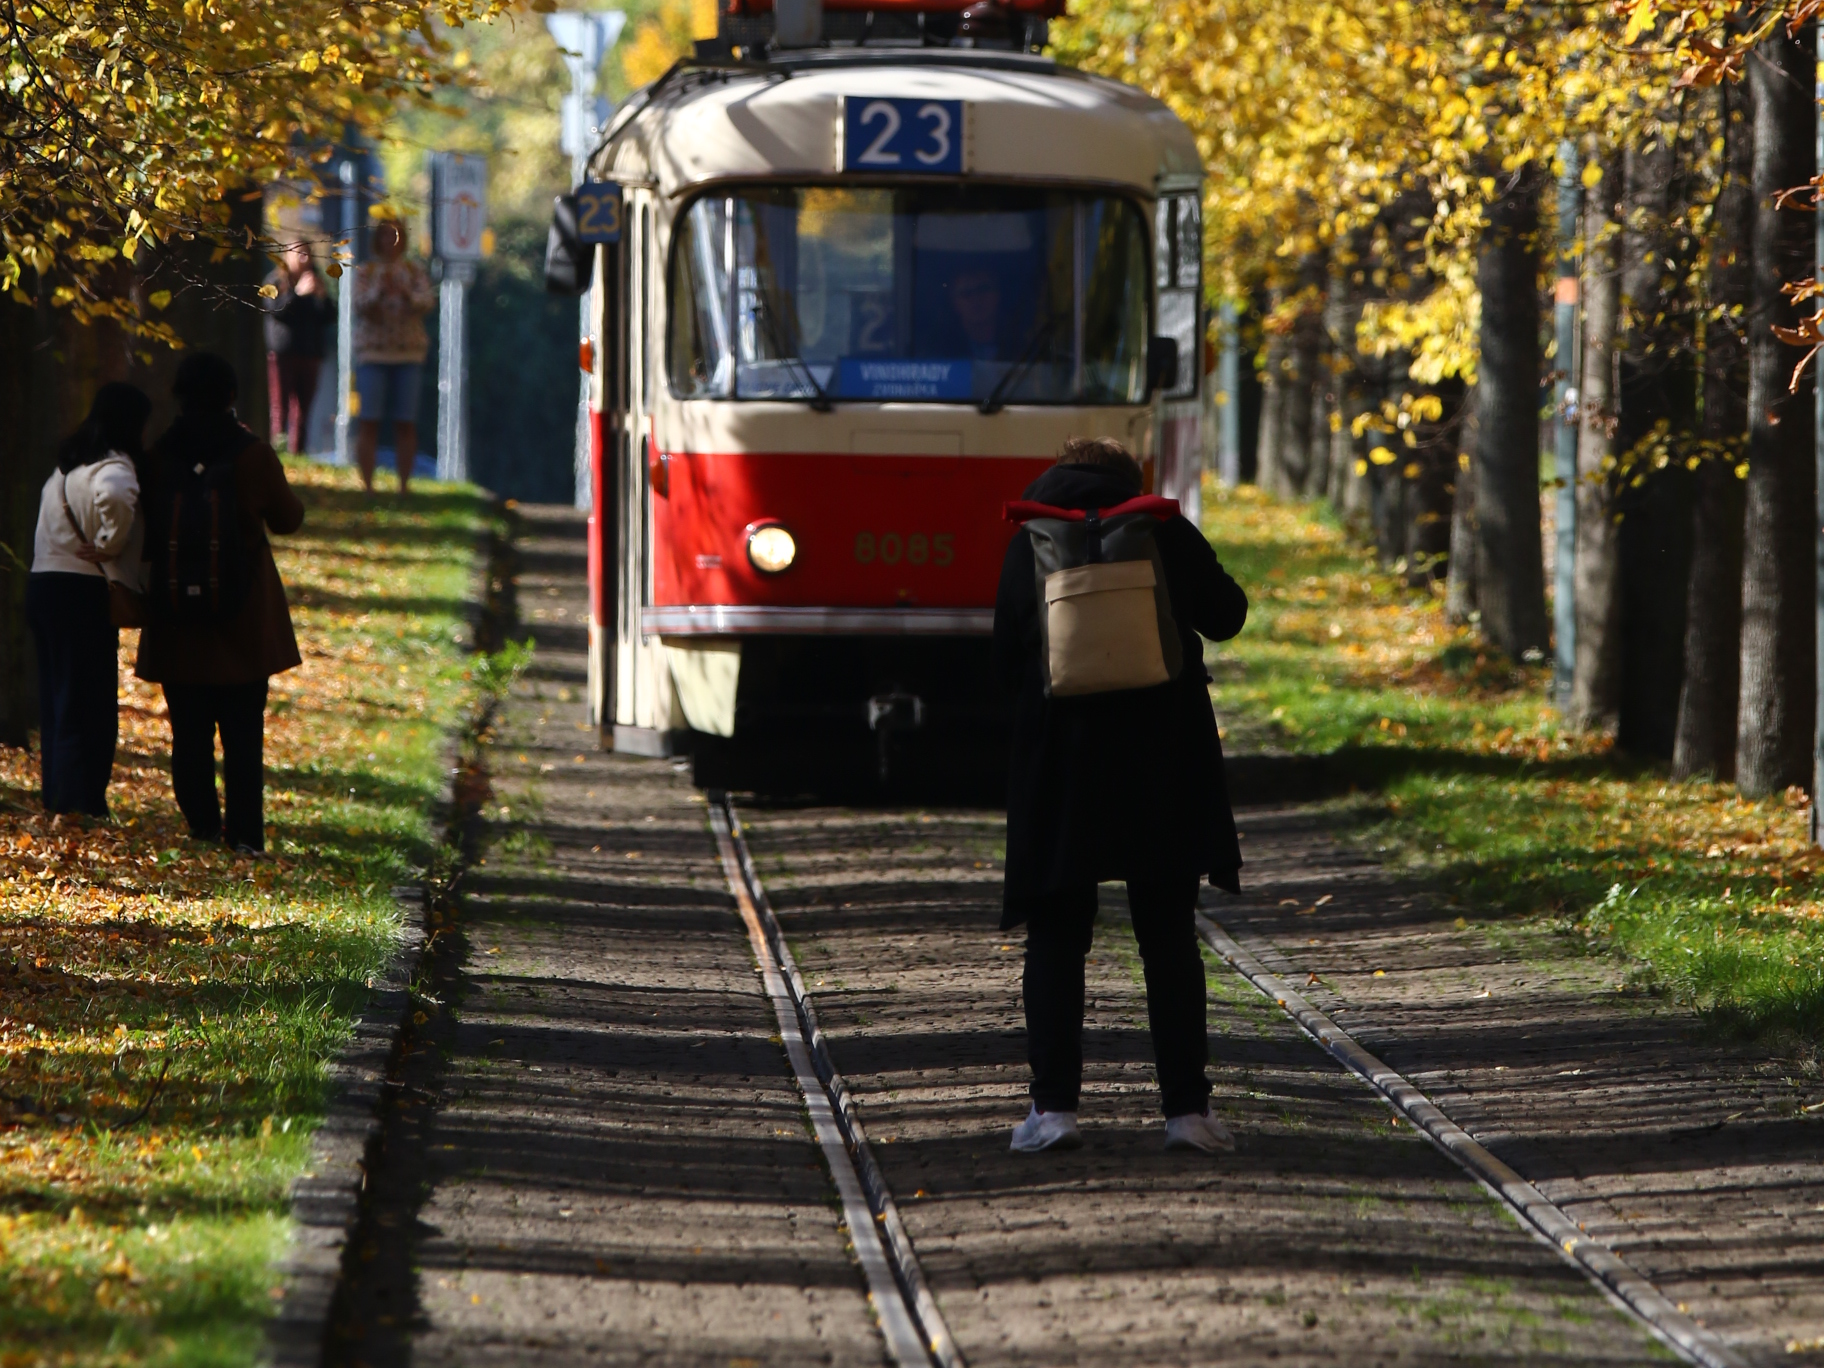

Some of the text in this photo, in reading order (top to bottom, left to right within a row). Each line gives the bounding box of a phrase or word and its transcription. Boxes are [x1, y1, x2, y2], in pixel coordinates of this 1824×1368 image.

[858, 100, 951, 165] 23
[579, 194, 620, 233] 23
[854, 532, 954, 566] 8085
